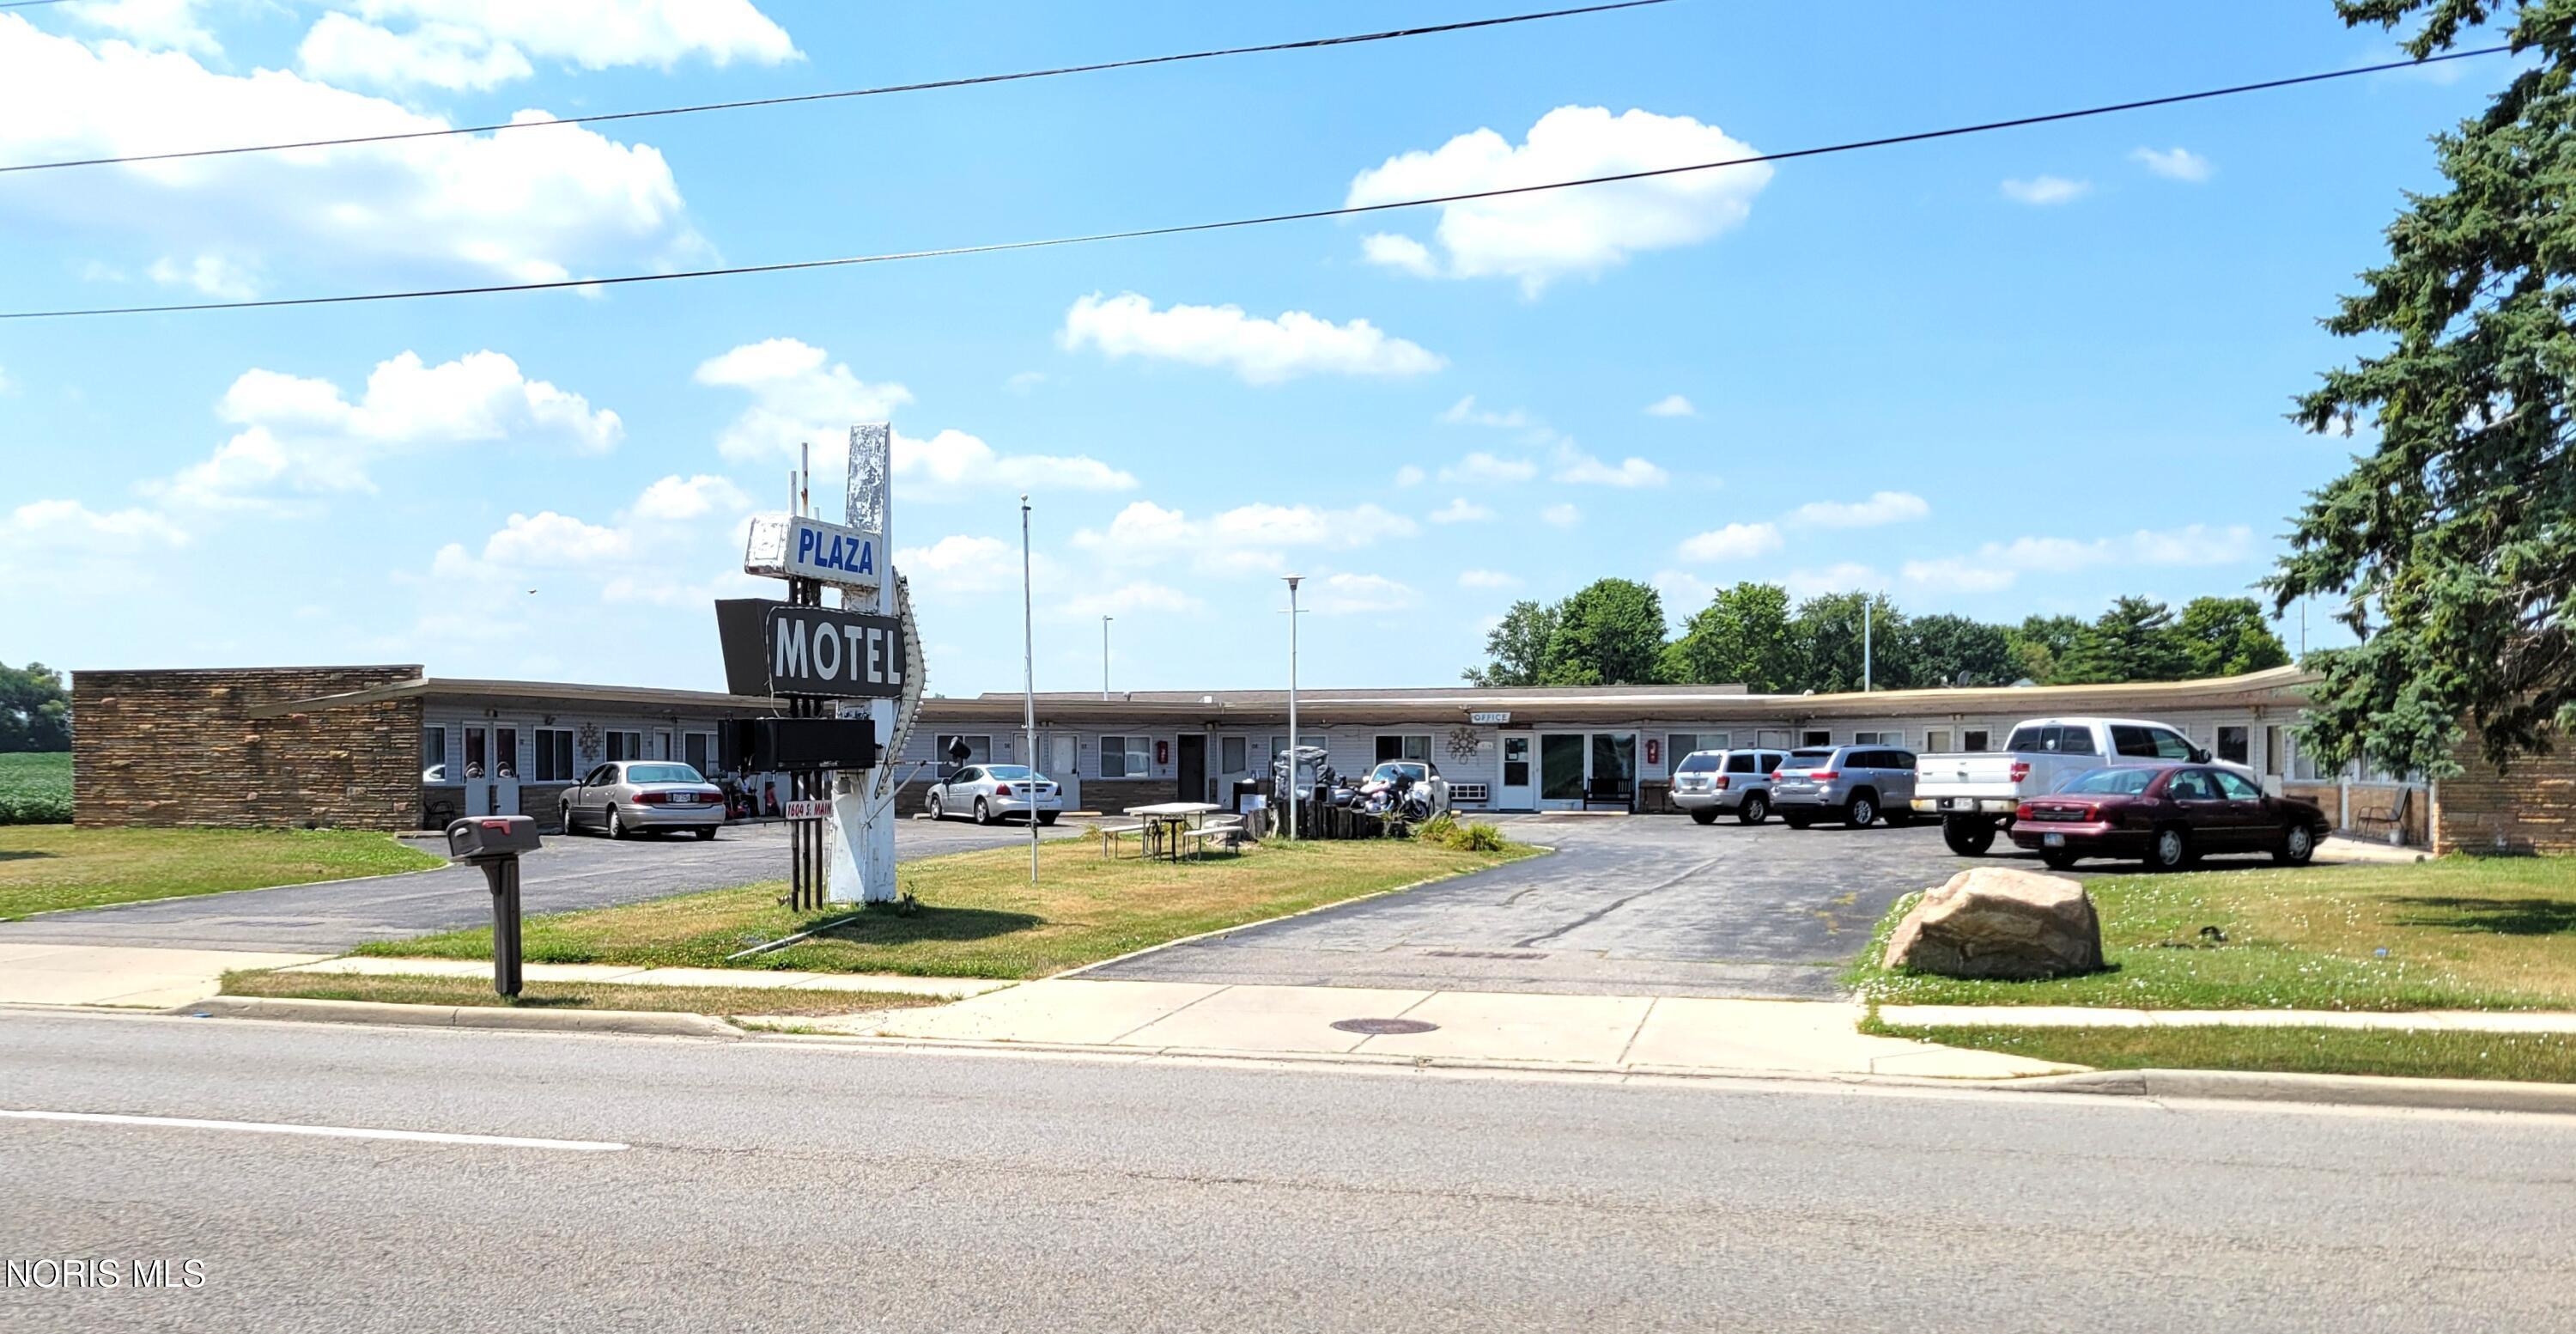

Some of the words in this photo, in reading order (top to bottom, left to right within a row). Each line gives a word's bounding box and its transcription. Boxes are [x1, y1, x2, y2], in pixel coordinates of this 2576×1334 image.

[798, 528, 873, 576] PLAZA
[775, 617, 901, 685] MOTEL
[787, 803, 804, 817] 1604
[814, 802, 832, 816] MAIN
